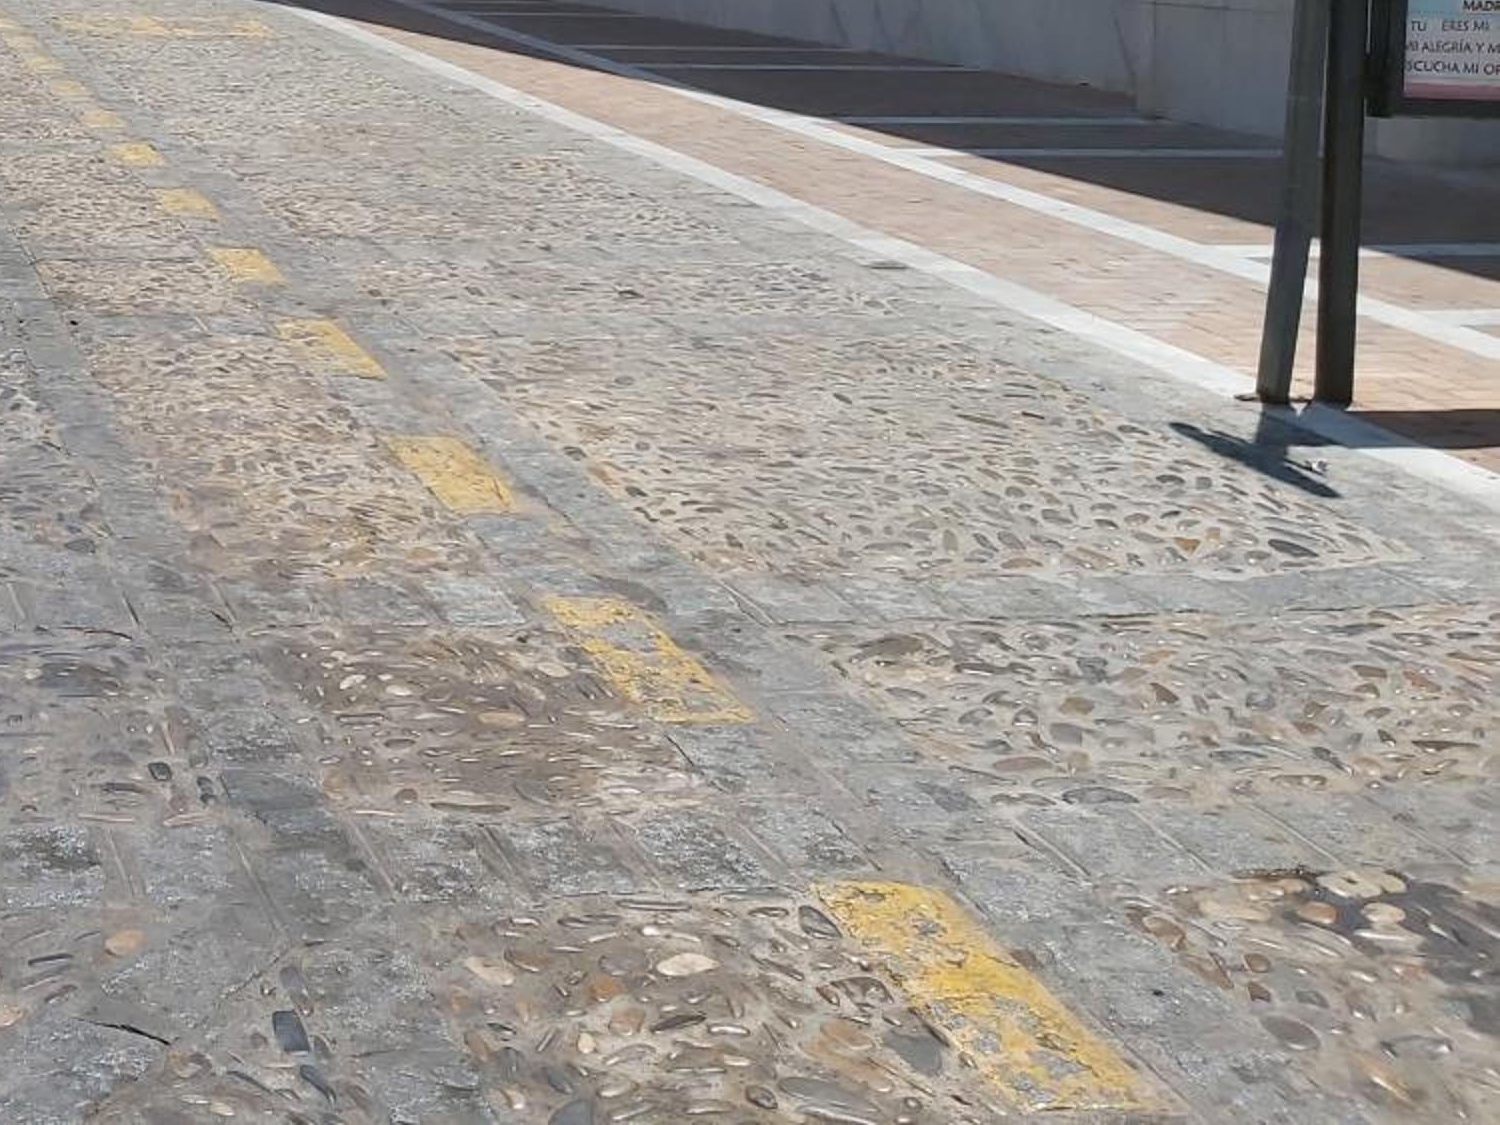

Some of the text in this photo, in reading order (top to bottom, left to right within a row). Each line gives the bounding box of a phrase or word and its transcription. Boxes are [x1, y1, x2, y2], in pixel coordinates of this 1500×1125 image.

[1411, 20, 1490, 31] TU ERES MI
[1476, 42, 1485, 53] Y
[1463, 62, 1479, 74] MI
